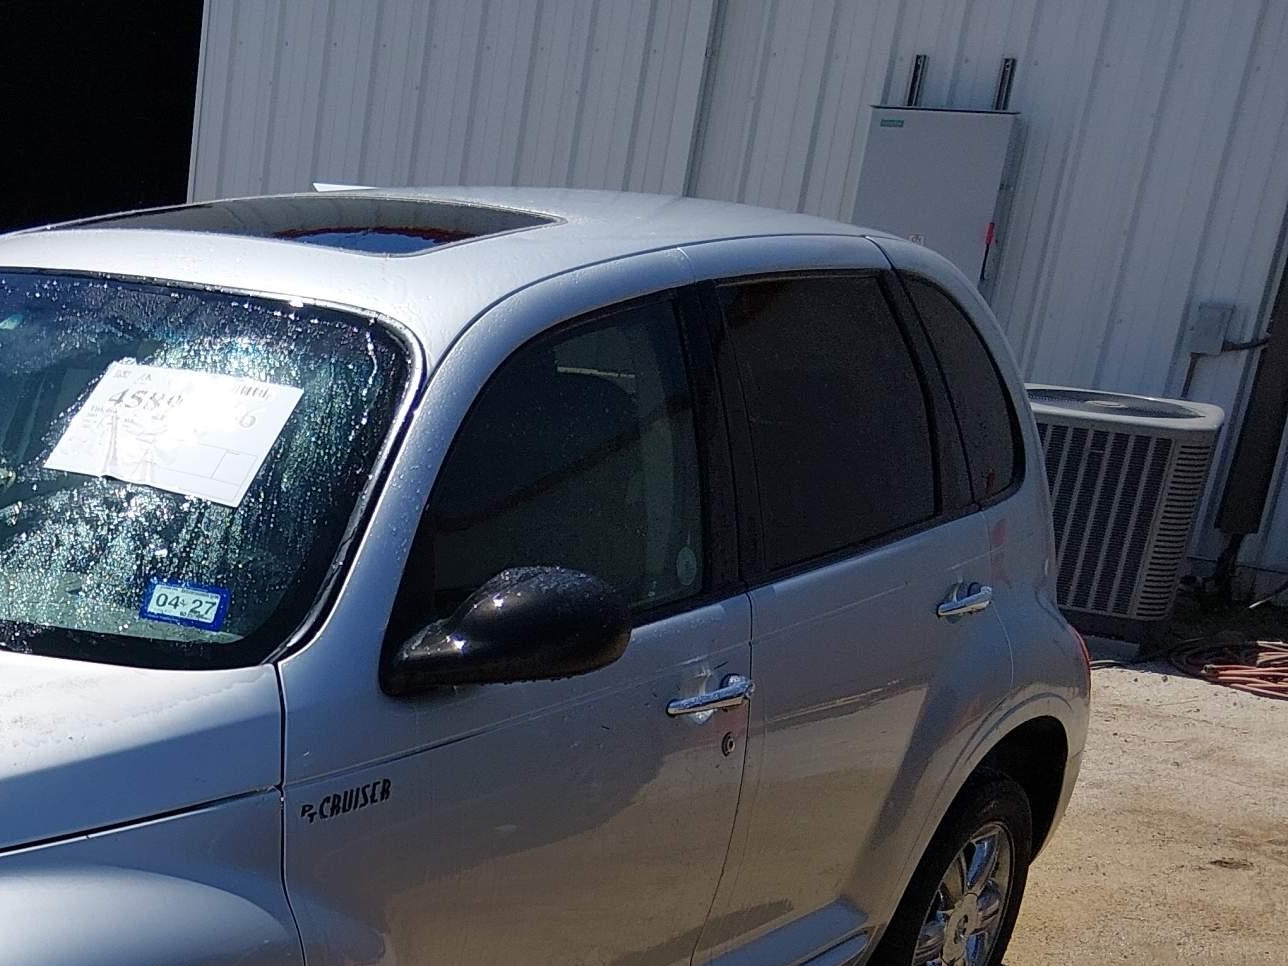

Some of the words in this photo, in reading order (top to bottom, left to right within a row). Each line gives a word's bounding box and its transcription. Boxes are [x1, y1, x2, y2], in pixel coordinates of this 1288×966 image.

[156, 593, 180, 610] 04
[189, 599, 216, 615] 27
[319, 779, 392, 819] CRUISER
